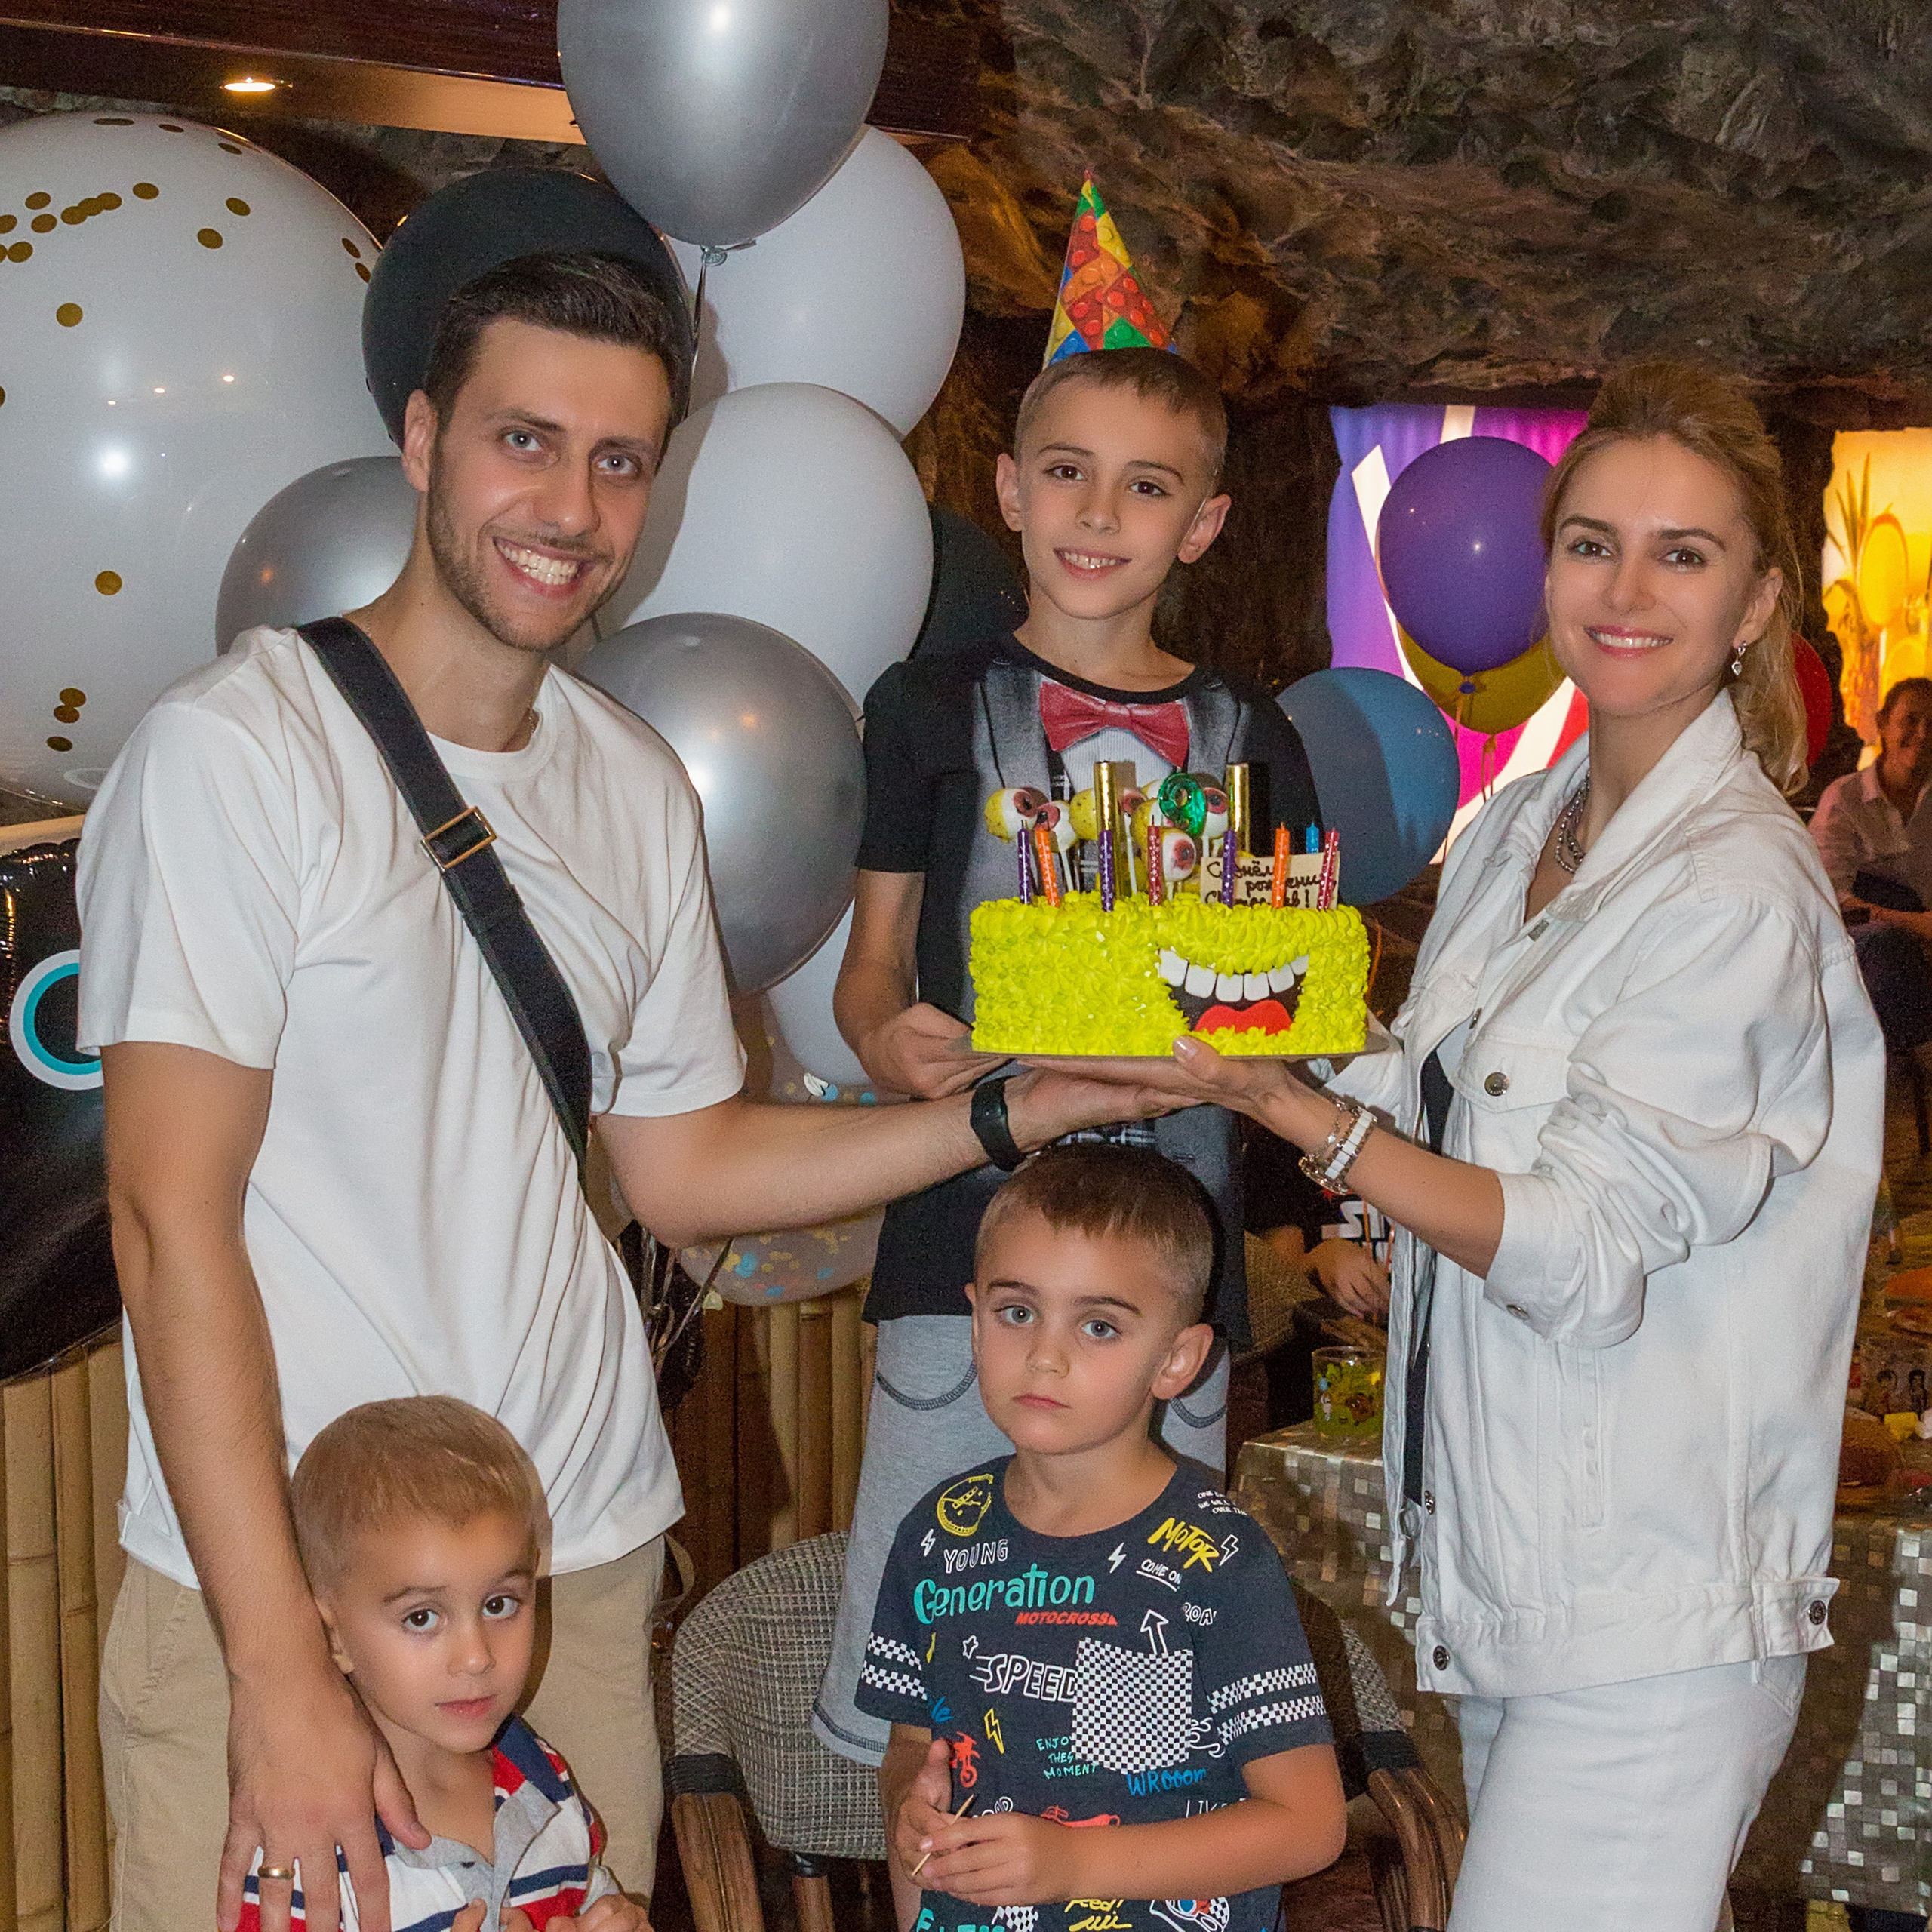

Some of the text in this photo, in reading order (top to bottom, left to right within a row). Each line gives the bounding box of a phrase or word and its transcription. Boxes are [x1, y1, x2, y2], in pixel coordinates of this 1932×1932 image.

[943, 1538, 1009, 1574] YOUNG
[1141, 1558, 1169, 1577] COME
[913, 1563, 1095, 1625] Generation
[1014, 1611, 1110, 1626] MOTOCROSS
[983, 1653, 1078, 1703] SPEED
